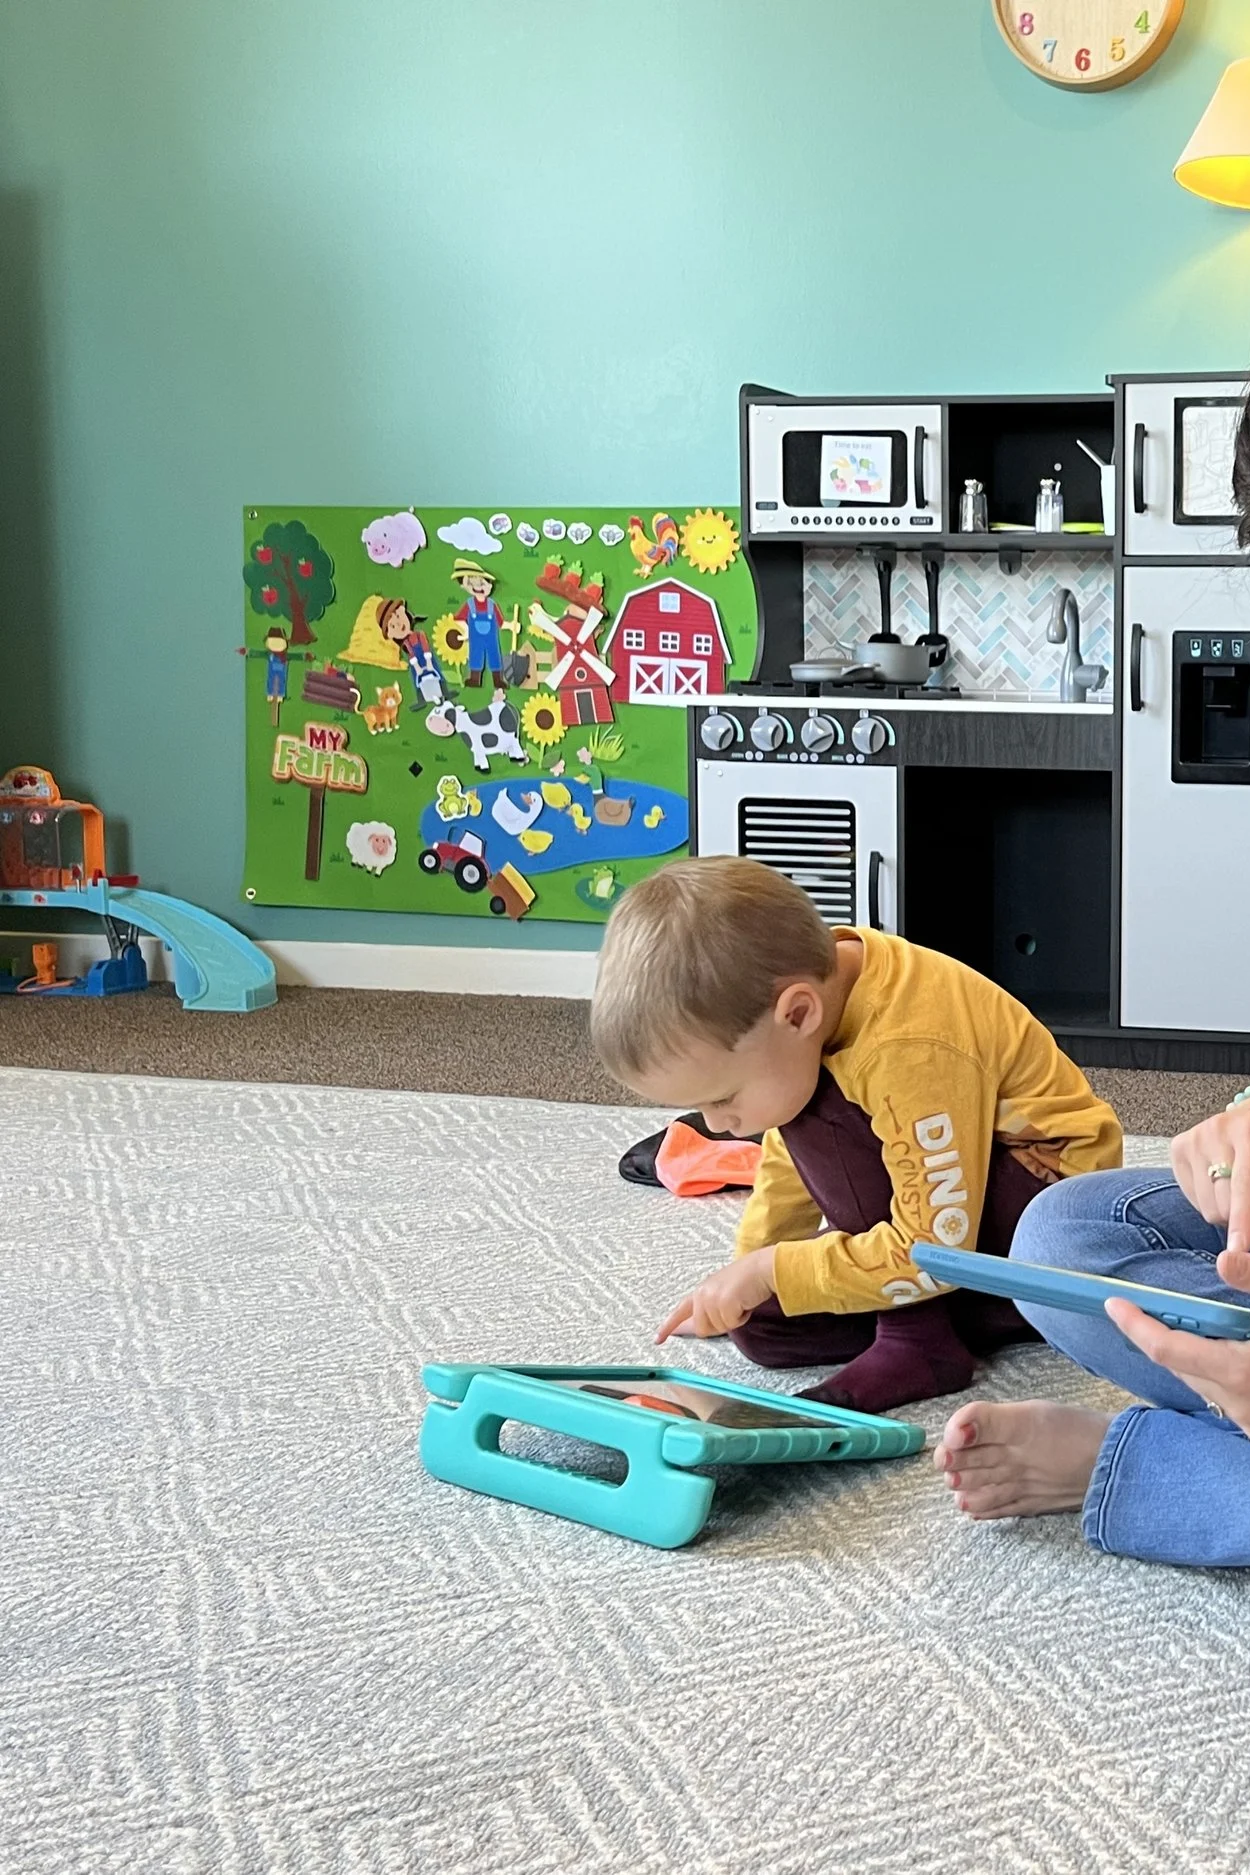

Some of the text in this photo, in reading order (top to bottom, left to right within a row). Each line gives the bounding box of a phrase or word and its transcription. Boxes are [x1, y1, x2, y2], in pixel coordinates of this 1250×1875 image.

[1019, 13, 1034, 35] 8
[1134, 10, 1150, 33] 4
[1043, 39, 1057, 62] 7
[1075, 48, 1090, 71] 6
[1110, 37, 1125, 61] 5
[308, 727, 341, 751] MY
[275, 738, 363, 786] Farm
[914, 1112, 969, 1246] DINO
